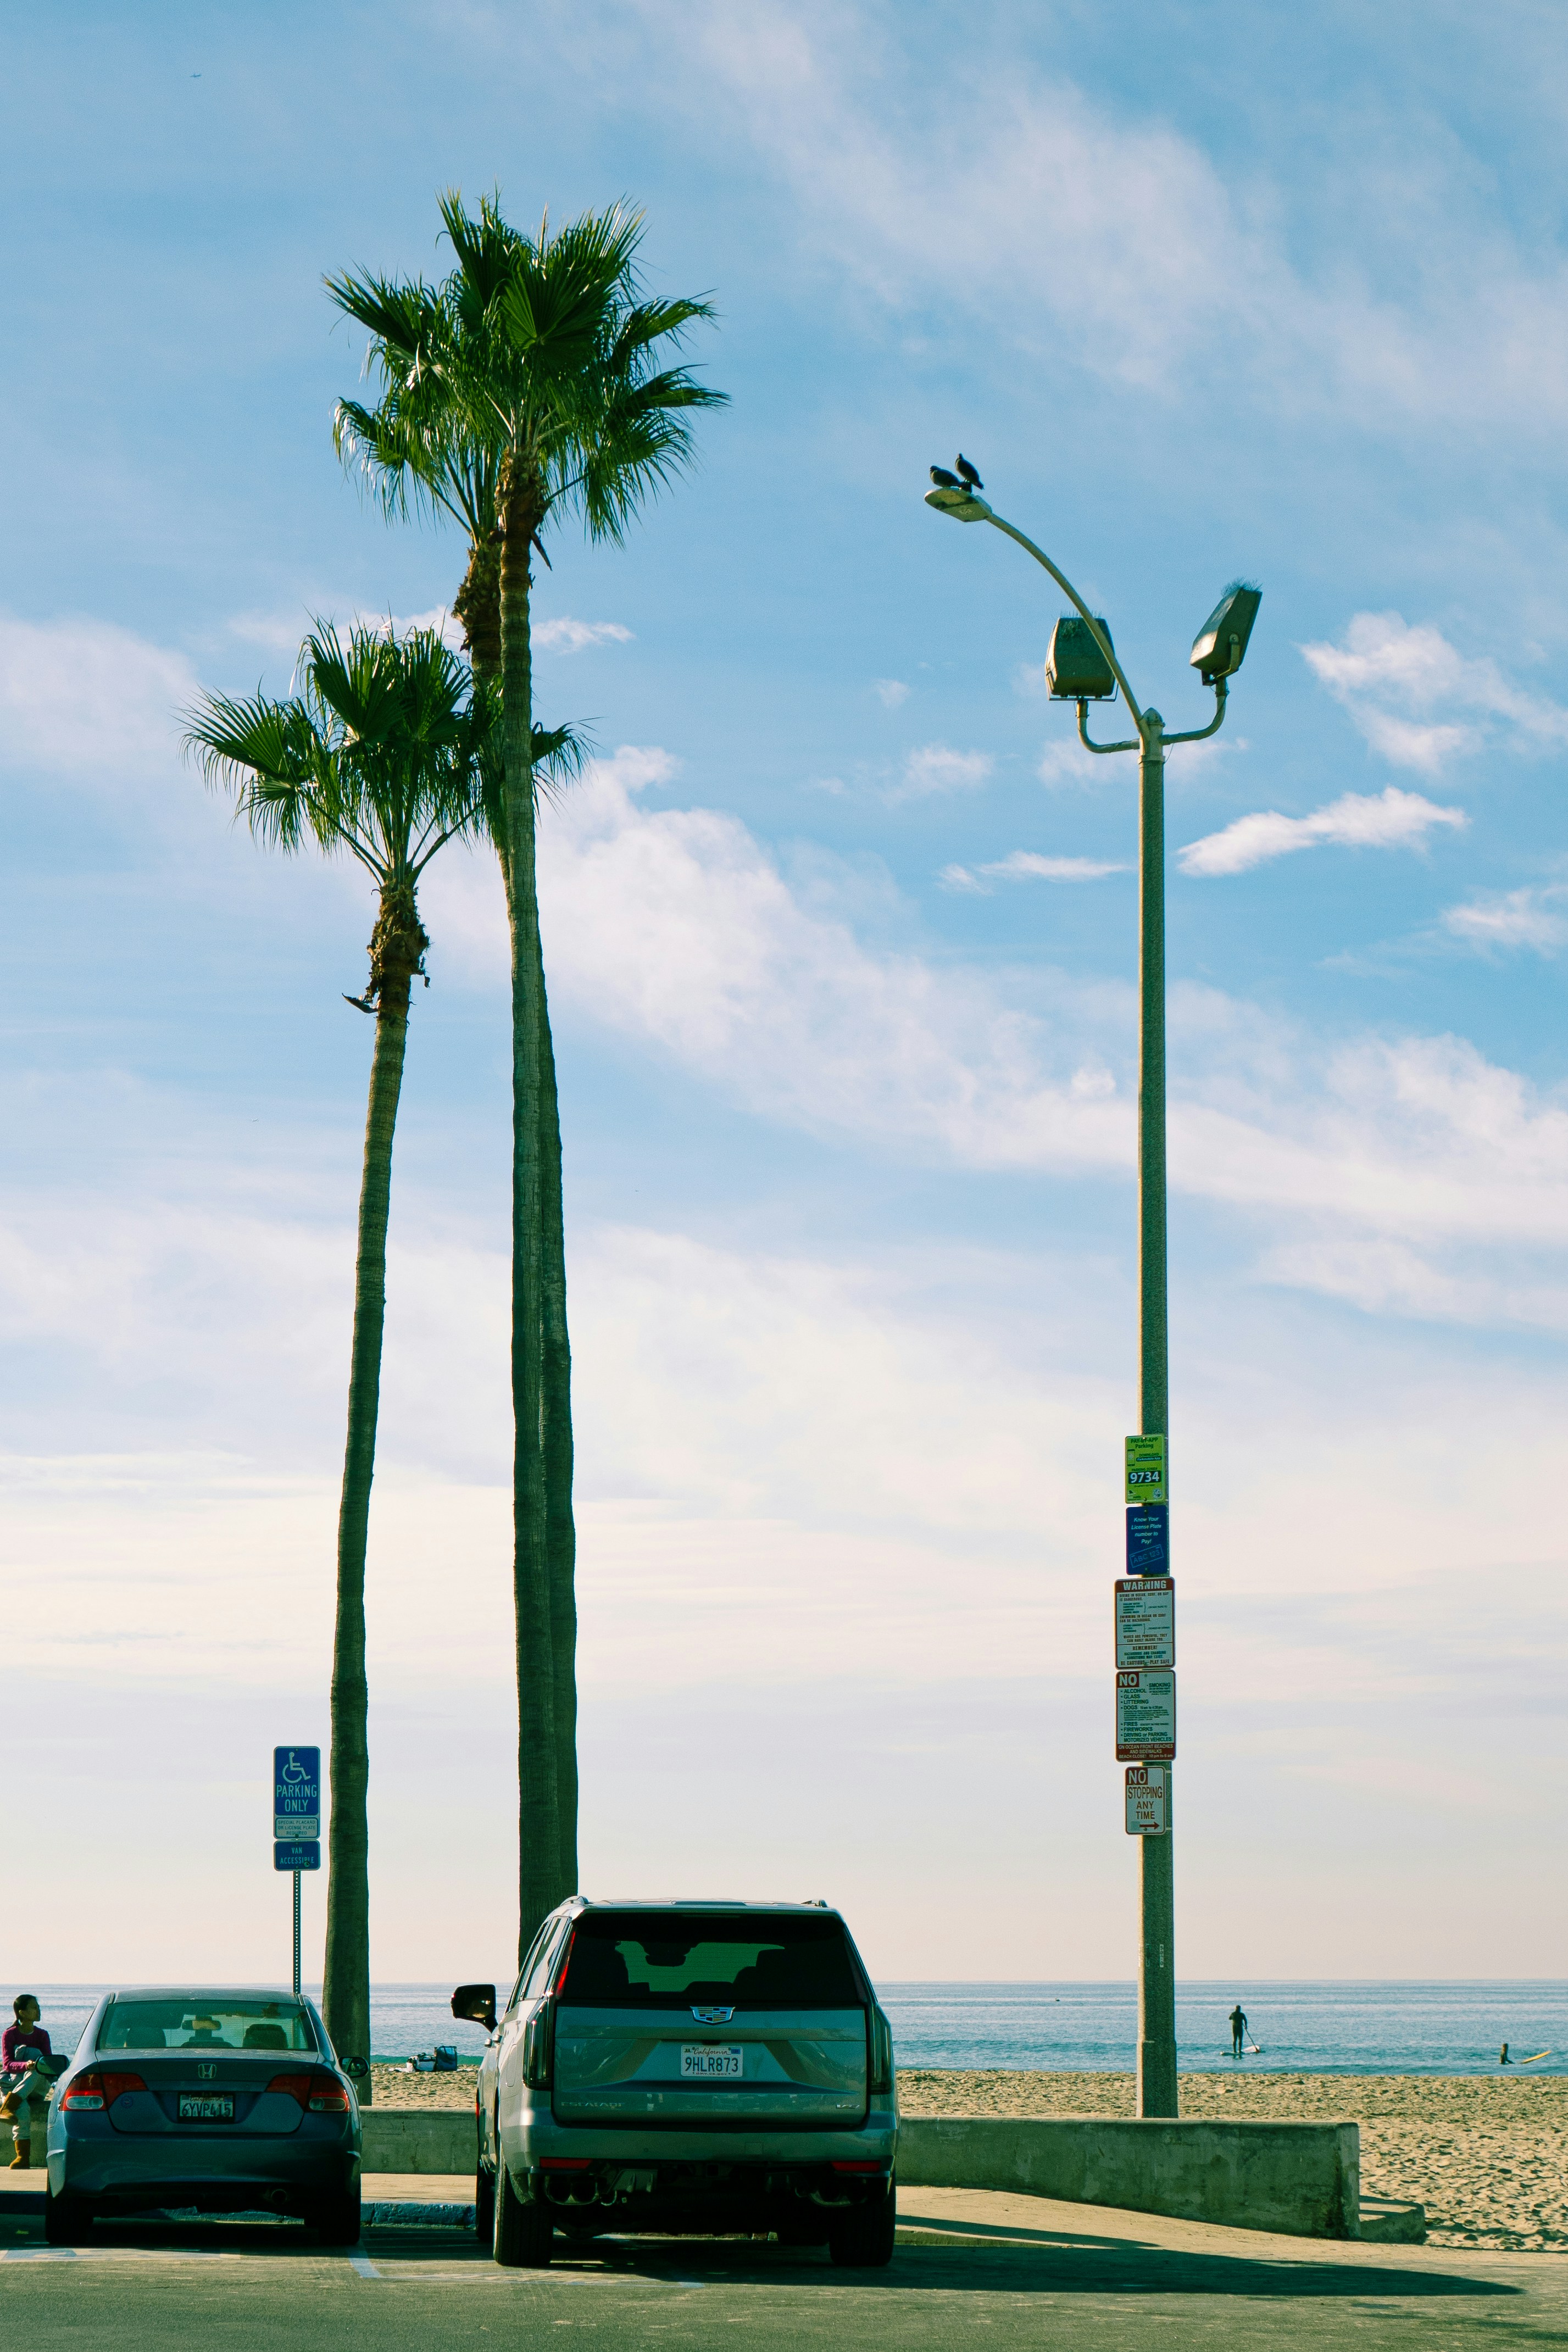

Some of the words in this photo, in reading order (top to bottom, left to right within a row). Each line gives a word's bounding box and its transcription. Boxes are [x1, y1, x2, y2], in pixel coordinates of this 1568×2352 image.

[1130, 1471, 1159, 1483] 9734
[1133, 1554, 1148, 1564] ABC
[1149, 1549, 1160, 1558] 123
[1123, 1580, 1167, 1591] WARNING
[1119, 1674, 1137, 1686] NO
[1128, 1769, 1147, 1784] NO
[276, 1784, 317, 1798] PARKING
[1128, 1786, 1163, 1799] STOPPING
[285, 1799, 309, 1812] ONLY
[1136, 1801, 1154, 1810] ANY
[1136, 1811, 1155, 1820] TIME
[693, 2047, 731, 2057] California
[685, 2056, 738, 2072] 9HLR873
[182, 2103, 231, 2117] 6YVP415
